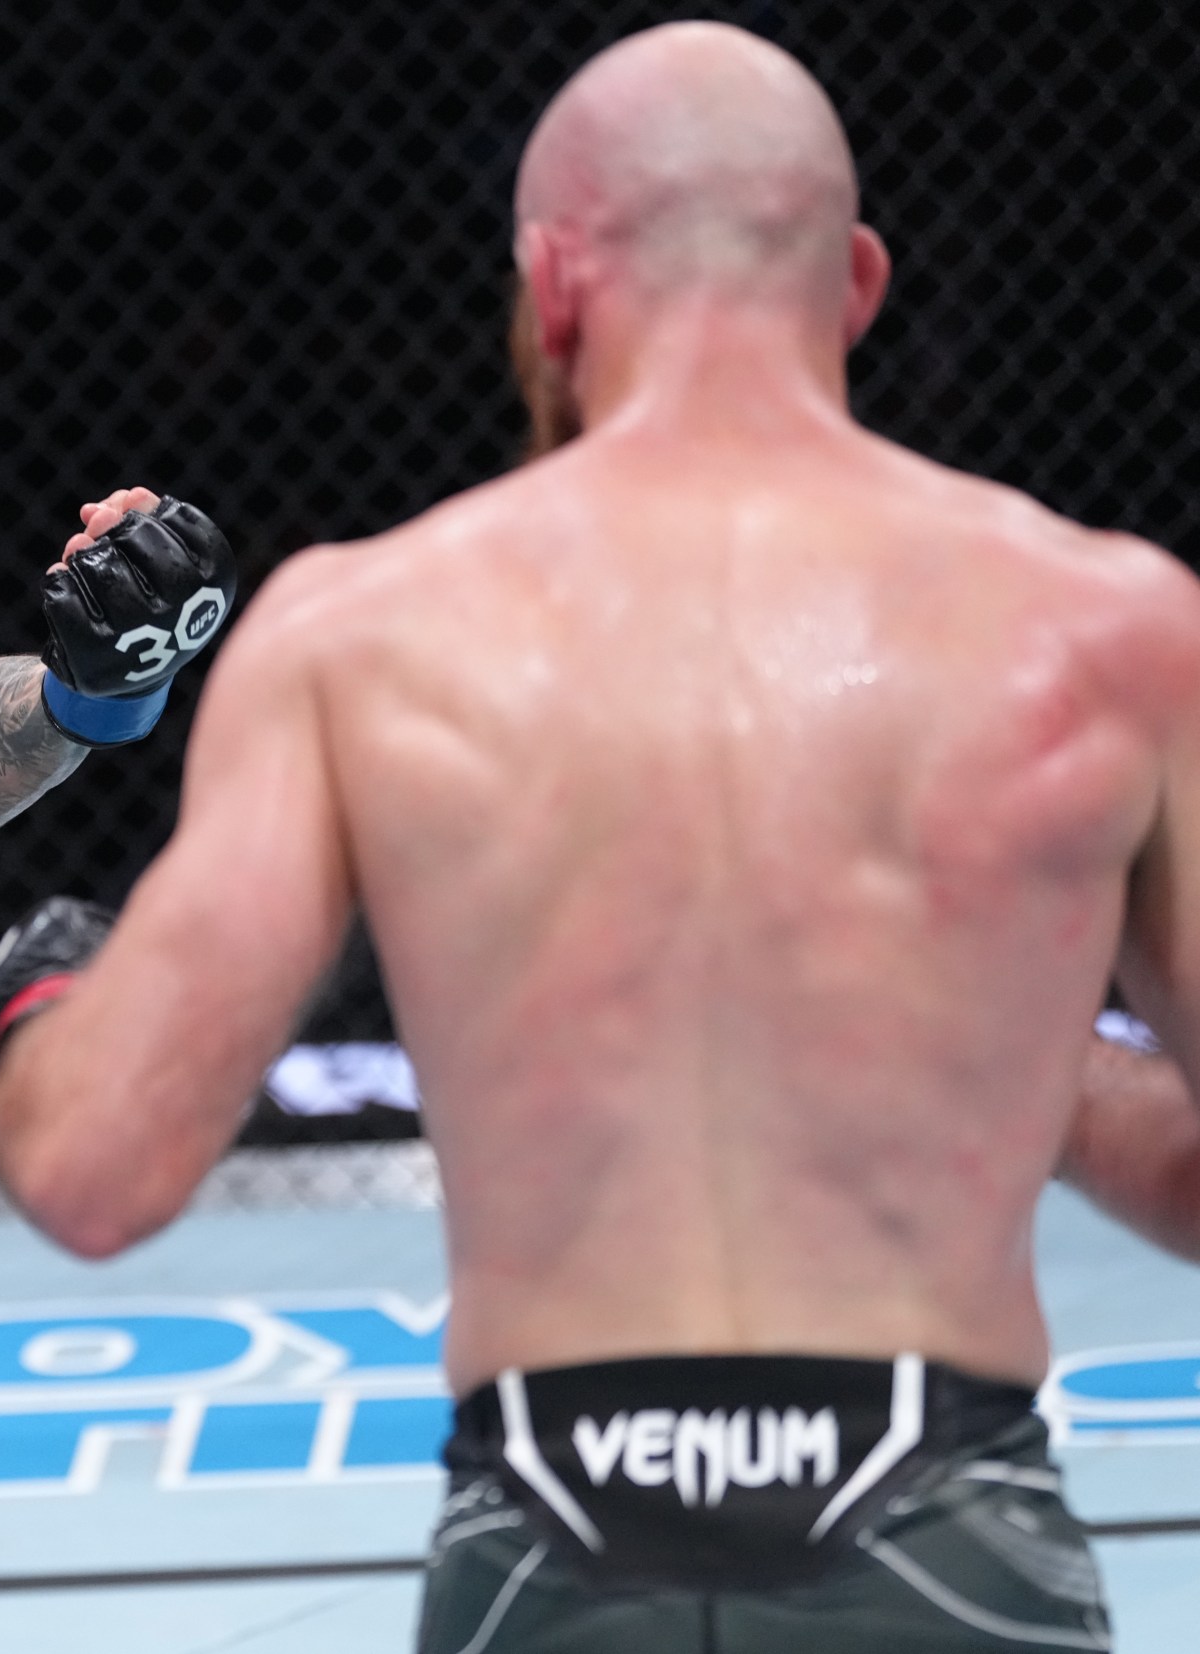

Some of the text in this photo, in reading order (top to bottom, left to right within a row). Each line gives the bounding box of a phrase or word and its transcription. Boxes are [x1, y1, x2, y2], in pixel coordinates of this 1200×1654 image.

[115, 586, 226, 682] 30
[190, 604, 216, 637] UFC
[572, 1406, 840, 1508] VENUM
